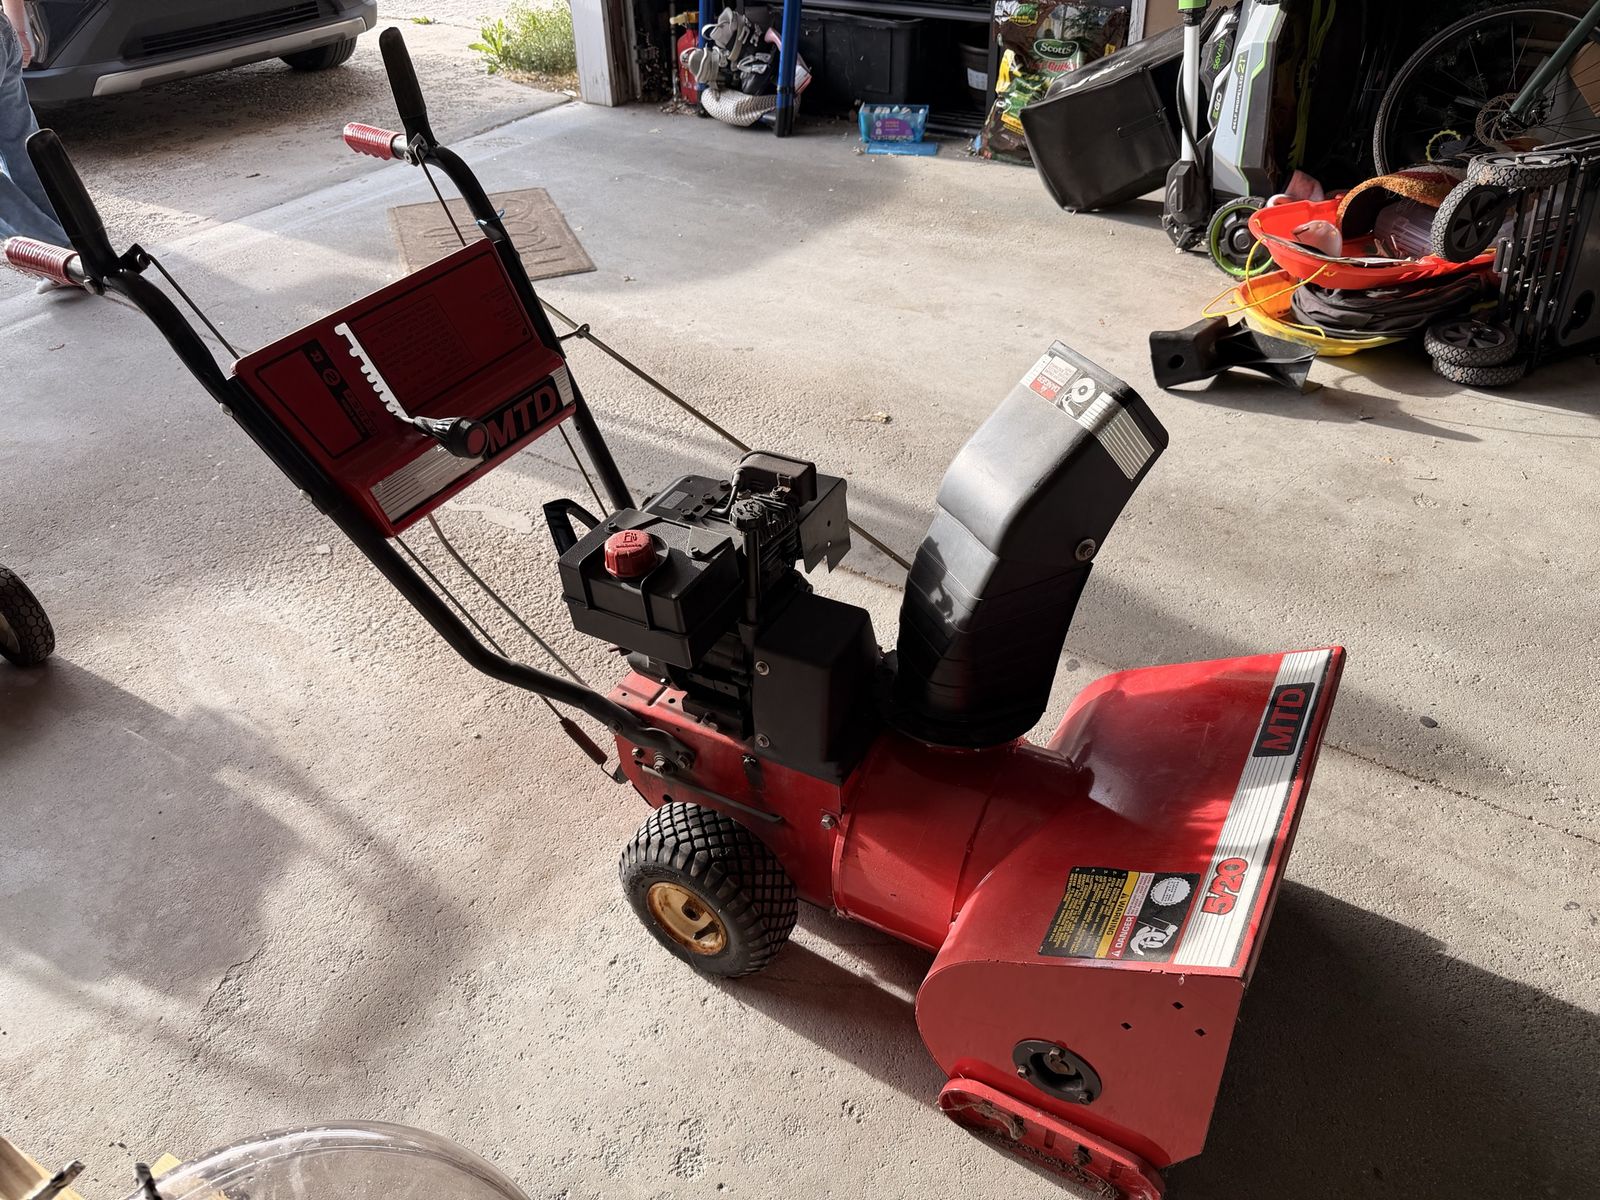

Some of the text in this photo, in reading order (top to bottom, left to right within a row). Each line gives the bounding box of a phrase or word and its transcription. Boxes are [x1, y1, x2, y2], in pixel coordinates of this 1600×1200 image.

[1040, 42, 1073, 55] Scotts
[1236, 75, 1244, 113] PROPELLED
[488, 386, 559, 453] MTD
[1262, 688, 1306, 751] MTD
[1106, 899, 1127, 936] WARNING
[1115, 916, 1135, 948] DANGER
